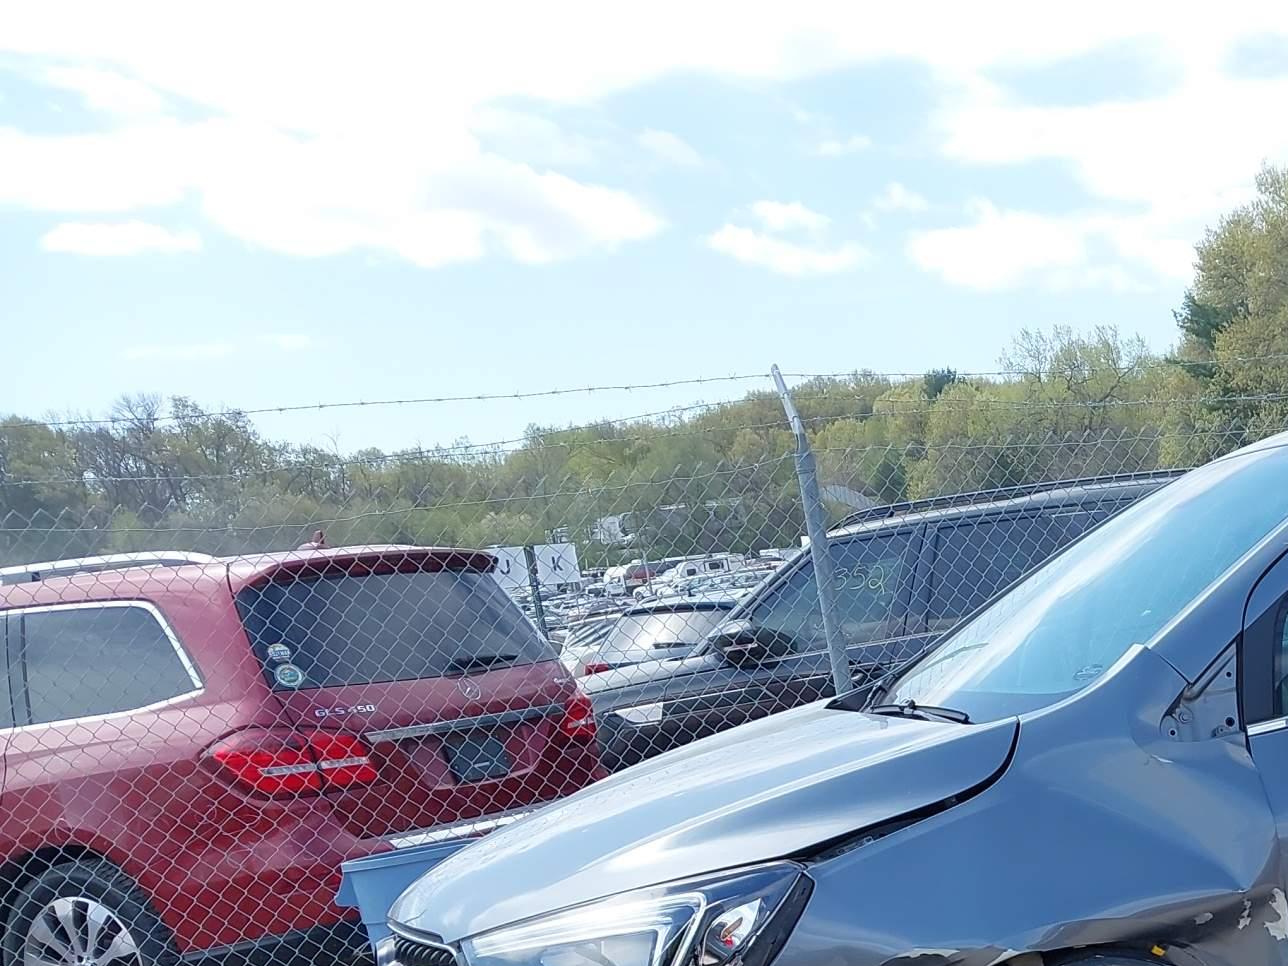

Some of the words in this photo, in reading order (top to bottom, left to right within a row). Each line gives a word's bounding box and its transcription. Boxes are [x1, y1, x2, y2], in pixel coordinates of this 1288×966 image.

[500, 559, 511, 575] J
[551, 555, 564, 571] K
[834, 565, 885, 595] 352
